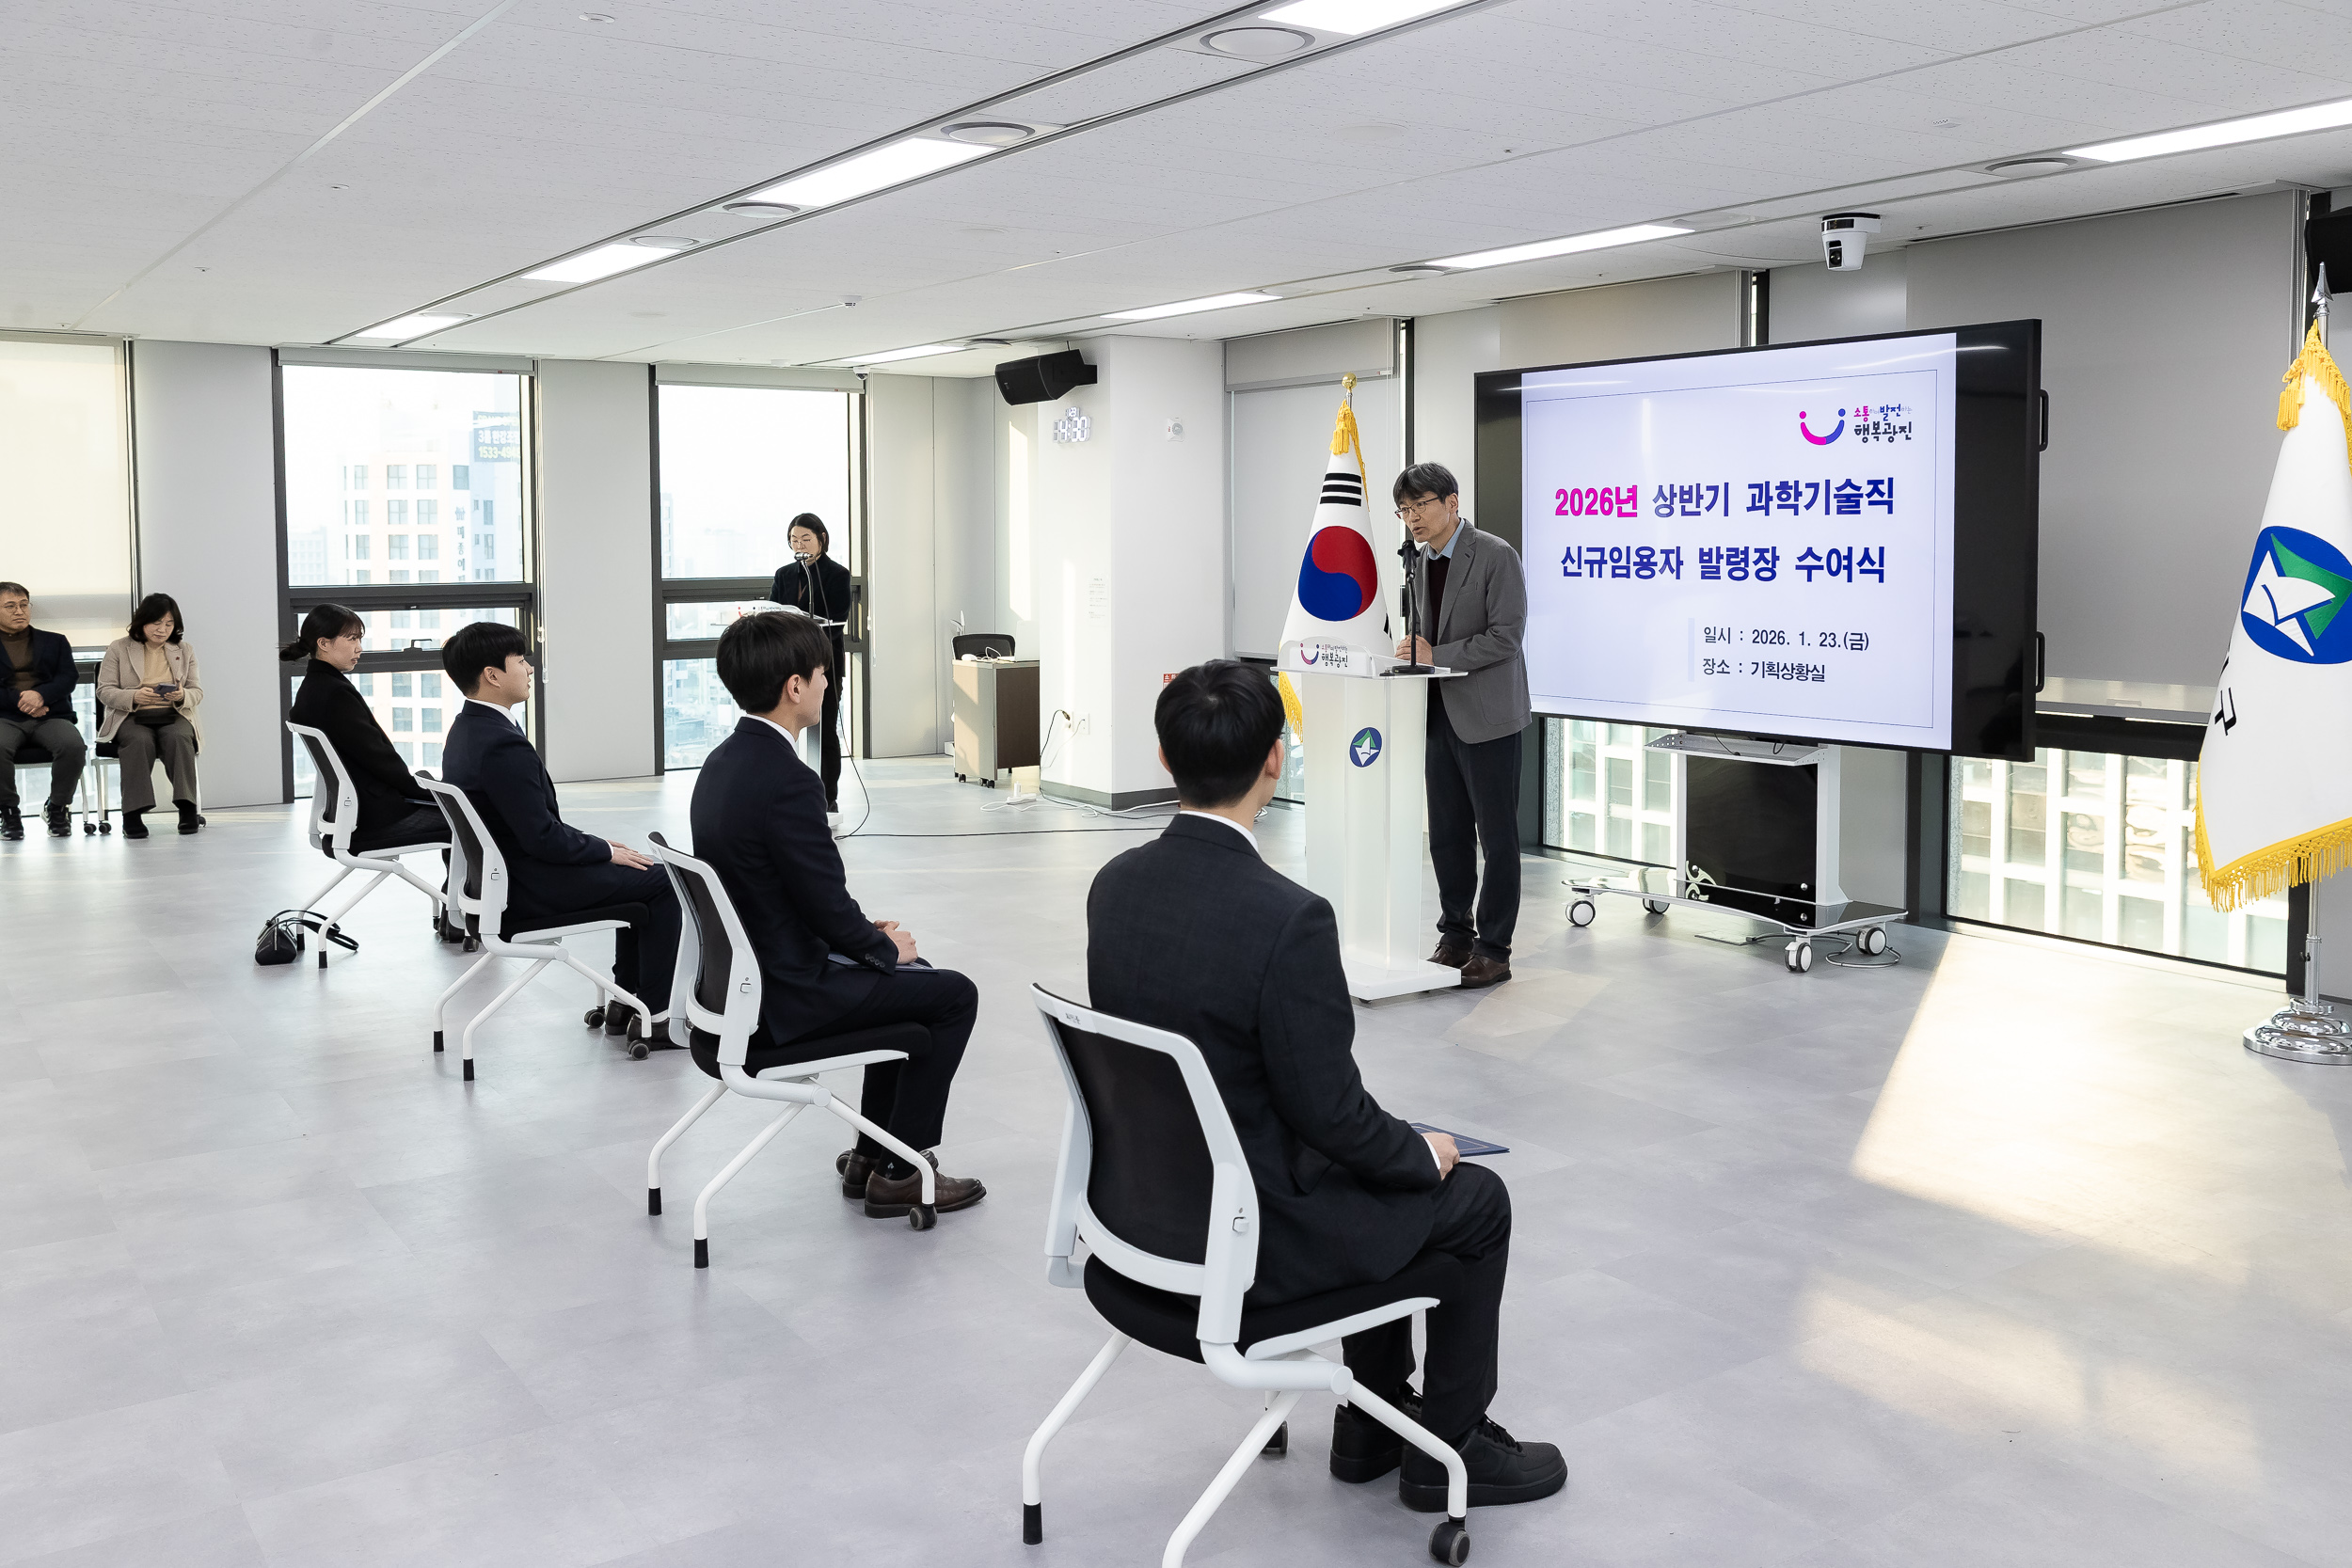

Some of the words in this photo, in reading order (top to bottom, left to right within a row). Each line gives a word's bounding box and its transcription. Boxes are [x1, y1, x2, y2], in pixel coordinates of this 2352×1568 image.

[1853, 420, 1913, 443] 행복광진
[1555, 484, 1638, 517] 2026년
[1652, 482, 1729, 517] 상반기
[1746, 477, 1894, 516] 과학기술직
[1561, 546, 1684, 579] 신규임용자
[1698, 546, 1780, 581] 발령장
[1795, 546, 1884, 583] 수여식
[1704, 626, 1731, 644] 일시
[1752, 628, 1790, 645] 2026.
[1799, 631, 1811, 646] 1.
[1819, 631, 1869, 651] 23.(금)
[1321, 652, 1348, 668] 행복광진
[1702, 657, 1731, 675] 장소
[1751, 661, 1825, 683] 기획상황실
